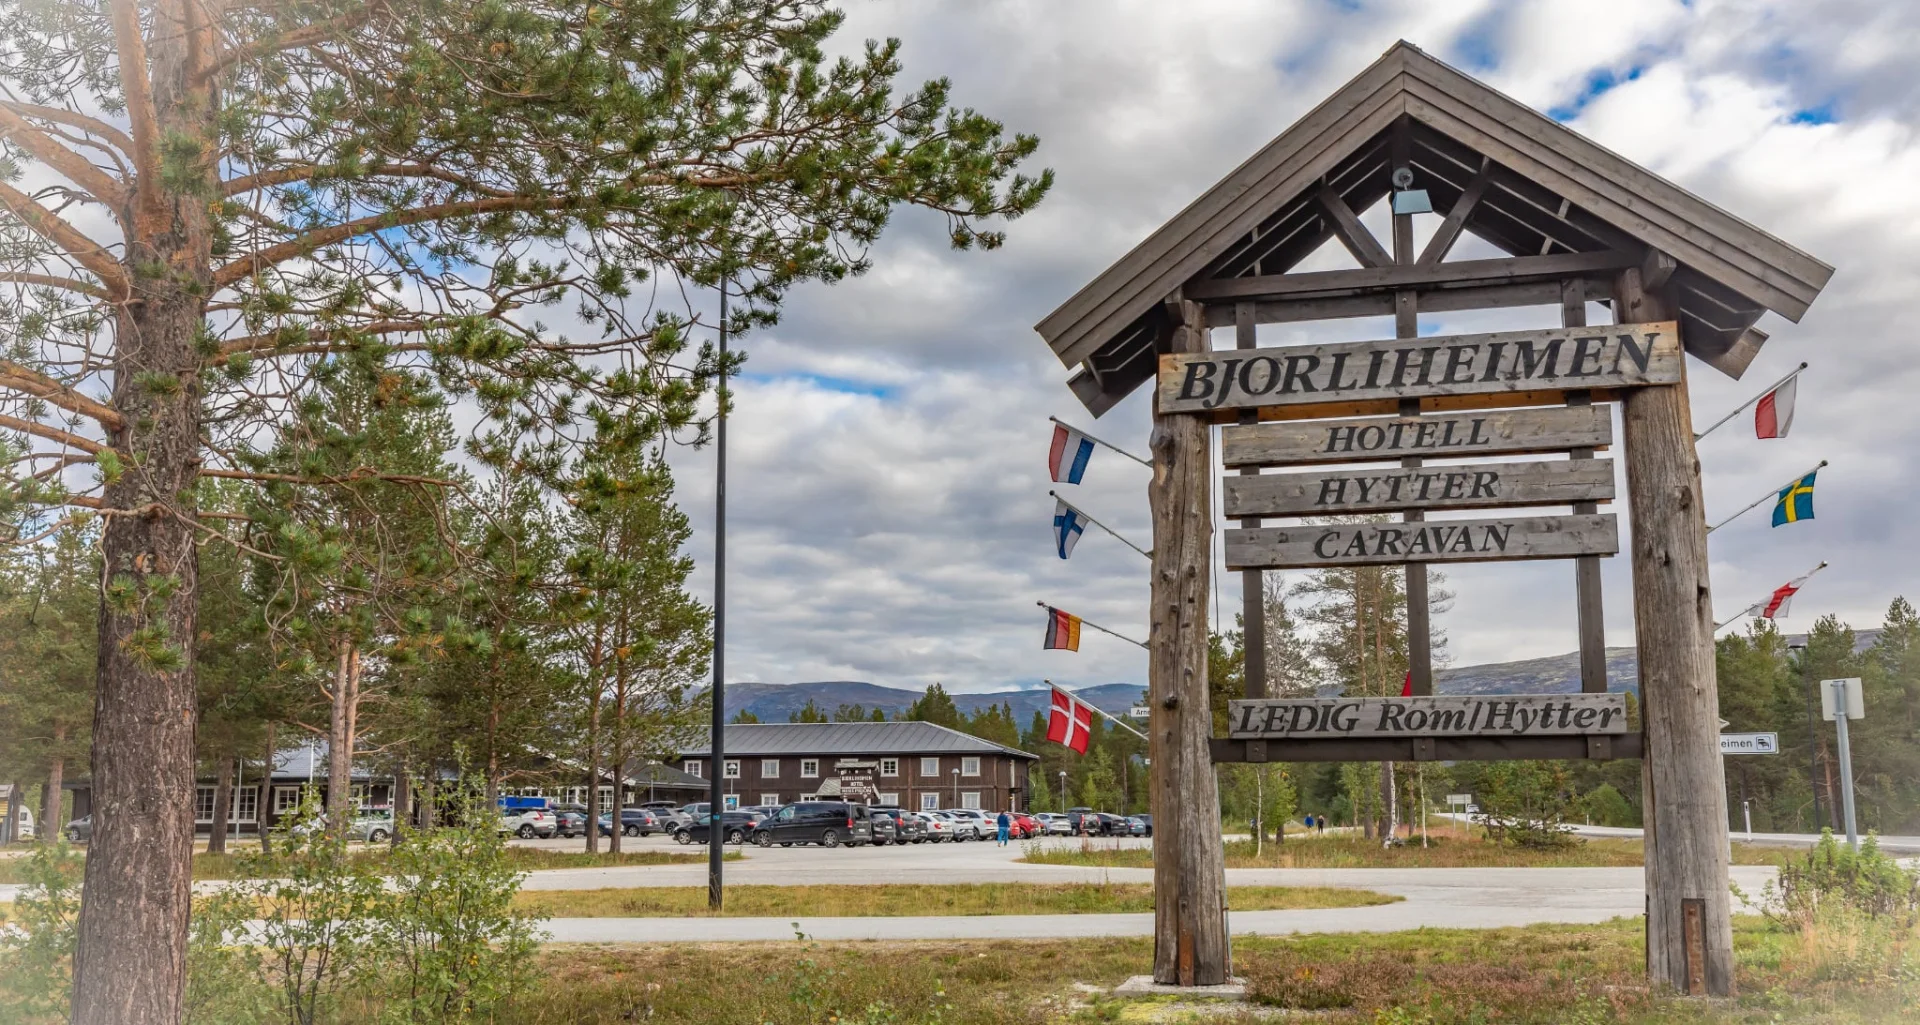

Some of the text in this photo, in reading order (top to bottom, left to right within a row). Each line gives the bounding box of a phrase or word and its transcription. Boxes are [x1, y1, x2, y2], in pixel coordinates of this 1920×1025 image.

[1175, 332, 1661, 409] BJORLIHEIMEN
[1322, 418, 1491, 453] HOTELL
[1314, 470, 1501, 506] HYTTER
[1313, 523, 1515, 559] CARAVAN
[1231, 701, 1622, 735] LEDIG Rom/Hytter
